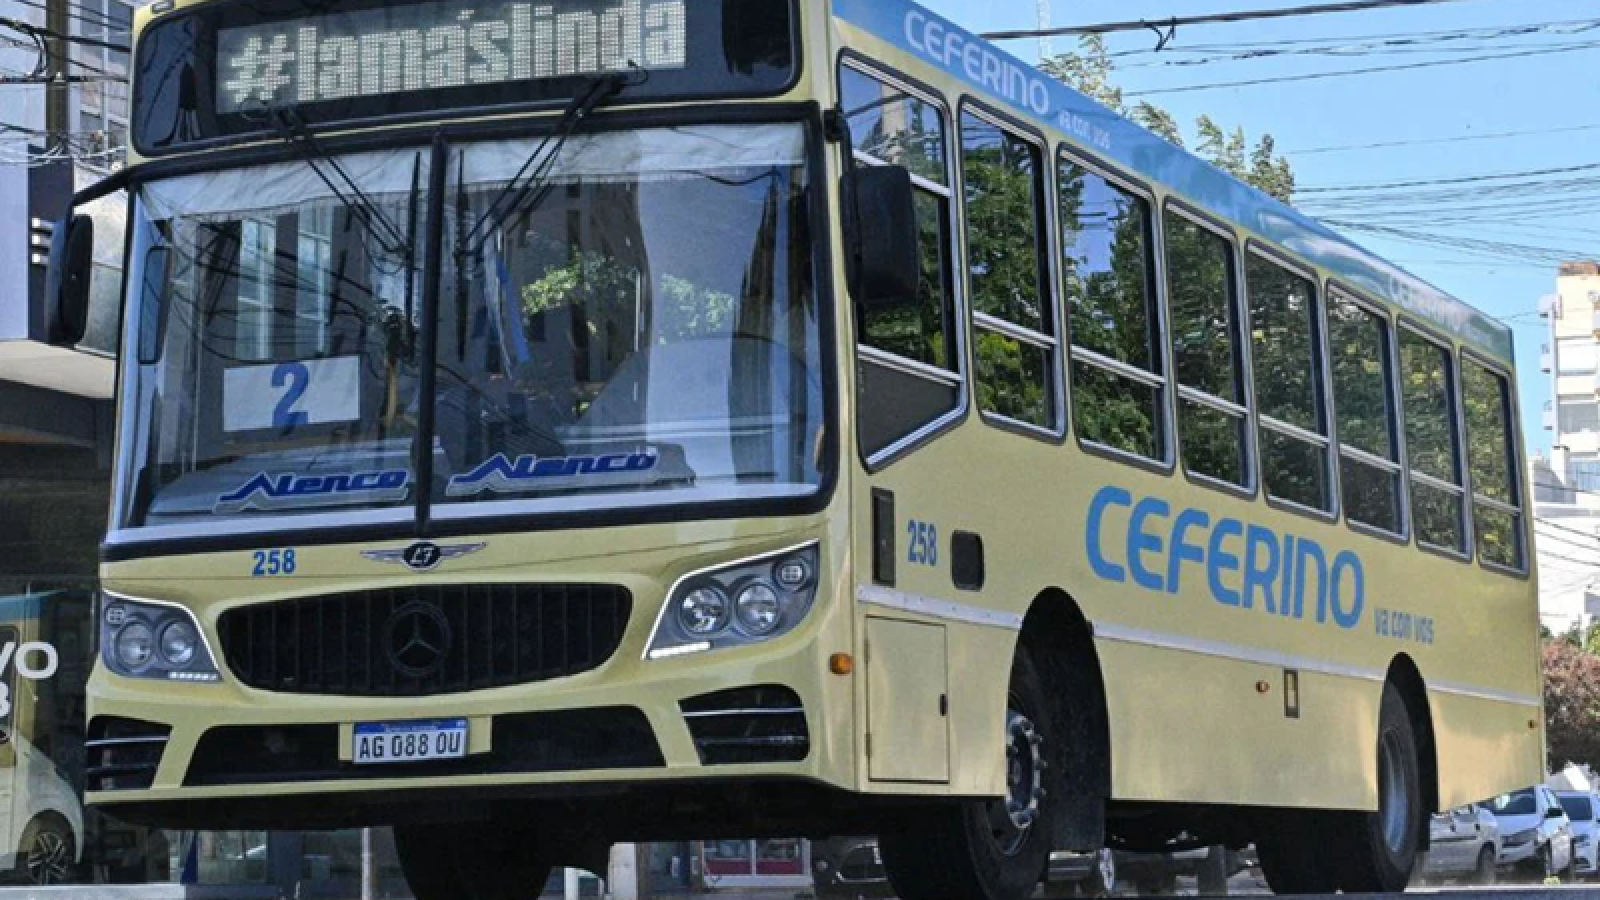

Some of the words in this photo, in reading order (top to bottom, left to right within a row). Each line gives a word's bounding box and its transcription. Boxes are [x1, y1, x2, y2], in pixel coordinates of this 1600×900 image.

[904, 9, 1050, 115] CEFERINO
[270, 362, 310, 429] 2
[252, 546, 296, 577] 258
[907, 518, 938, 567] 258
[1085, 485, 1365, 630] CEFERINO
[1391, 611, 1411, 641] con
[359, 735, 385, 759] AG
[391, 733, 429, 757] 088
